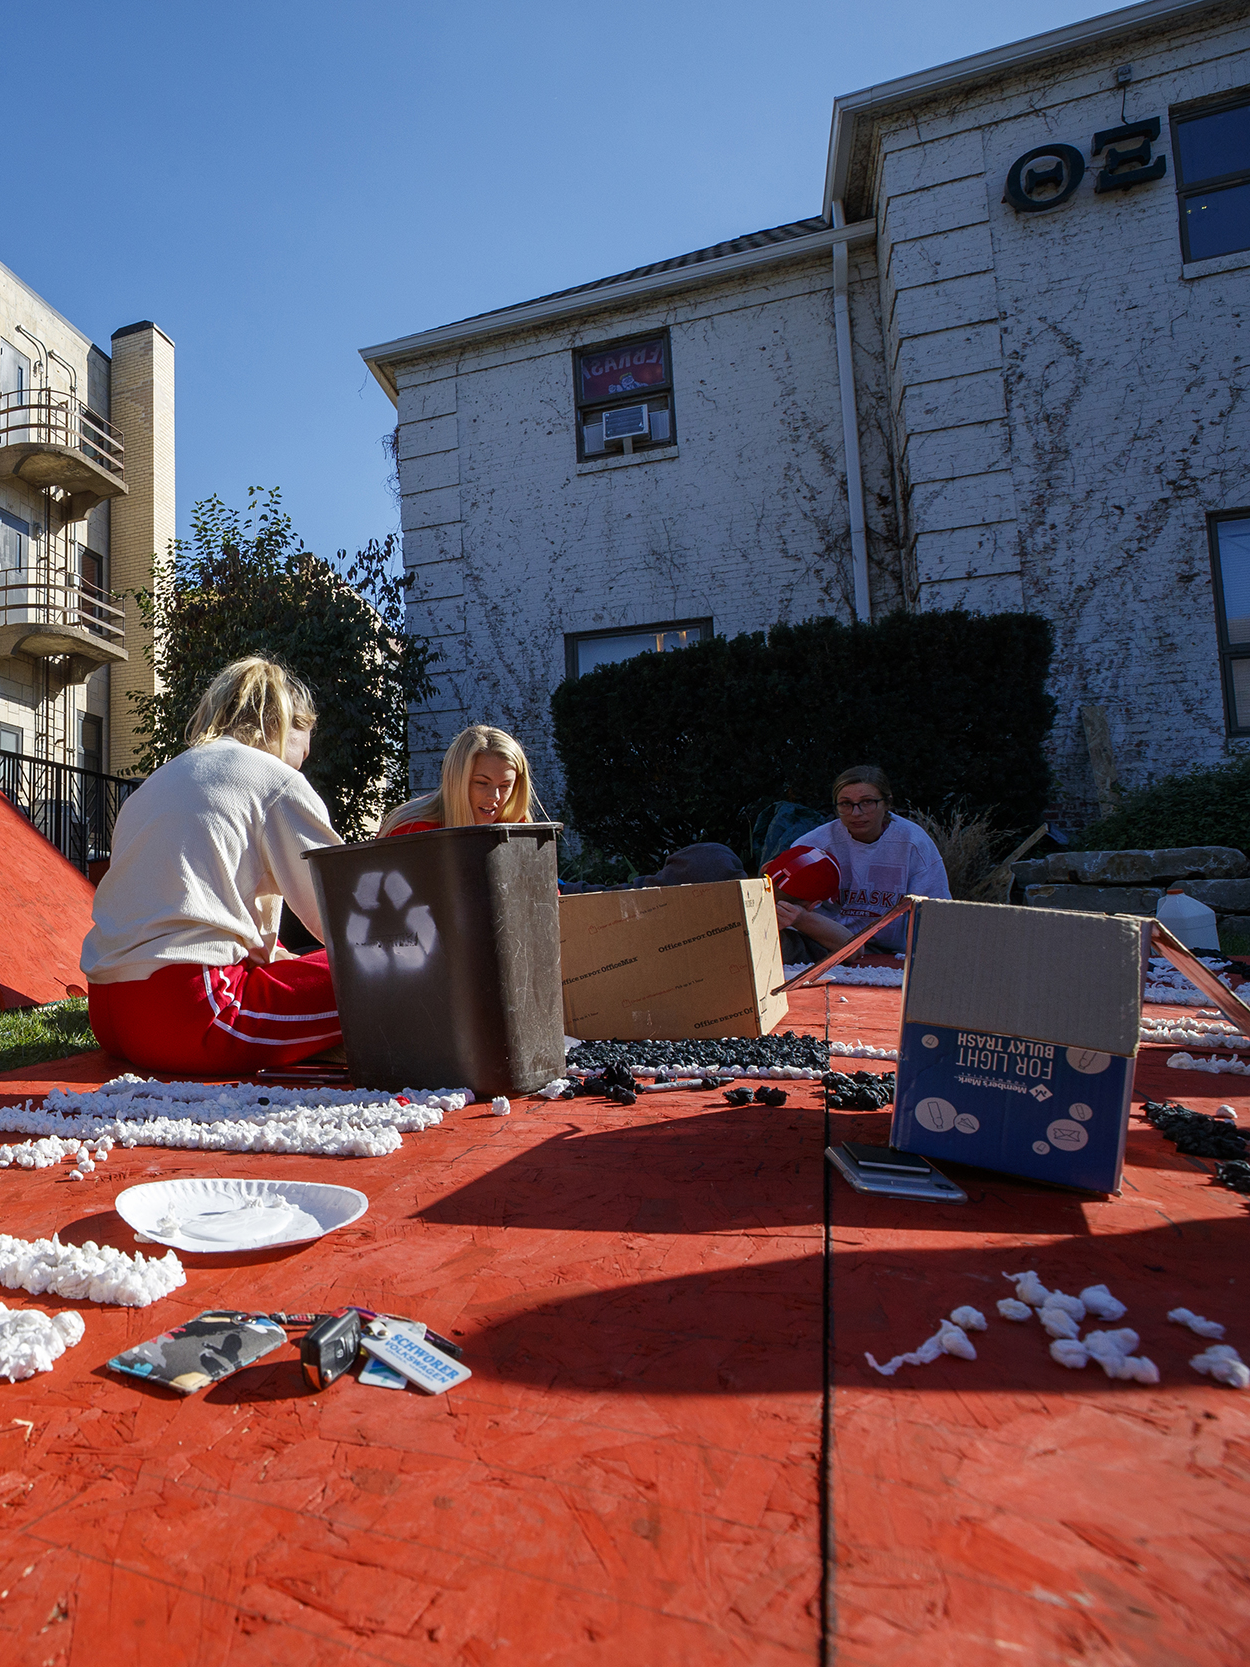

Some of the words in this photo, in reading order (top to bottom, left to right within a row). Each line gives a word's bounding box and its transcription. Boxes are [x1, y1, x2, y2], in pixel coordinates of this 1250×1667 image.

[658, 941, 683, 953] Office
[601, 956, 638, 974] OfficeMax
[693, 1017, 719, 1029] Office
[957, 1032, 1003, 1052] TRASH
[1007, 1039, 1055, 1059] BULKY
[955, 1047, 1009, 1073] LIGHT
[1015, 1056, 1053, 1080] FOR
[982, 1080, 1027, 1095] Member's
[385, 1340, 449, 1384] VOLKSWAGEN
[391, 1333, 460, 1380] SCHWORER
